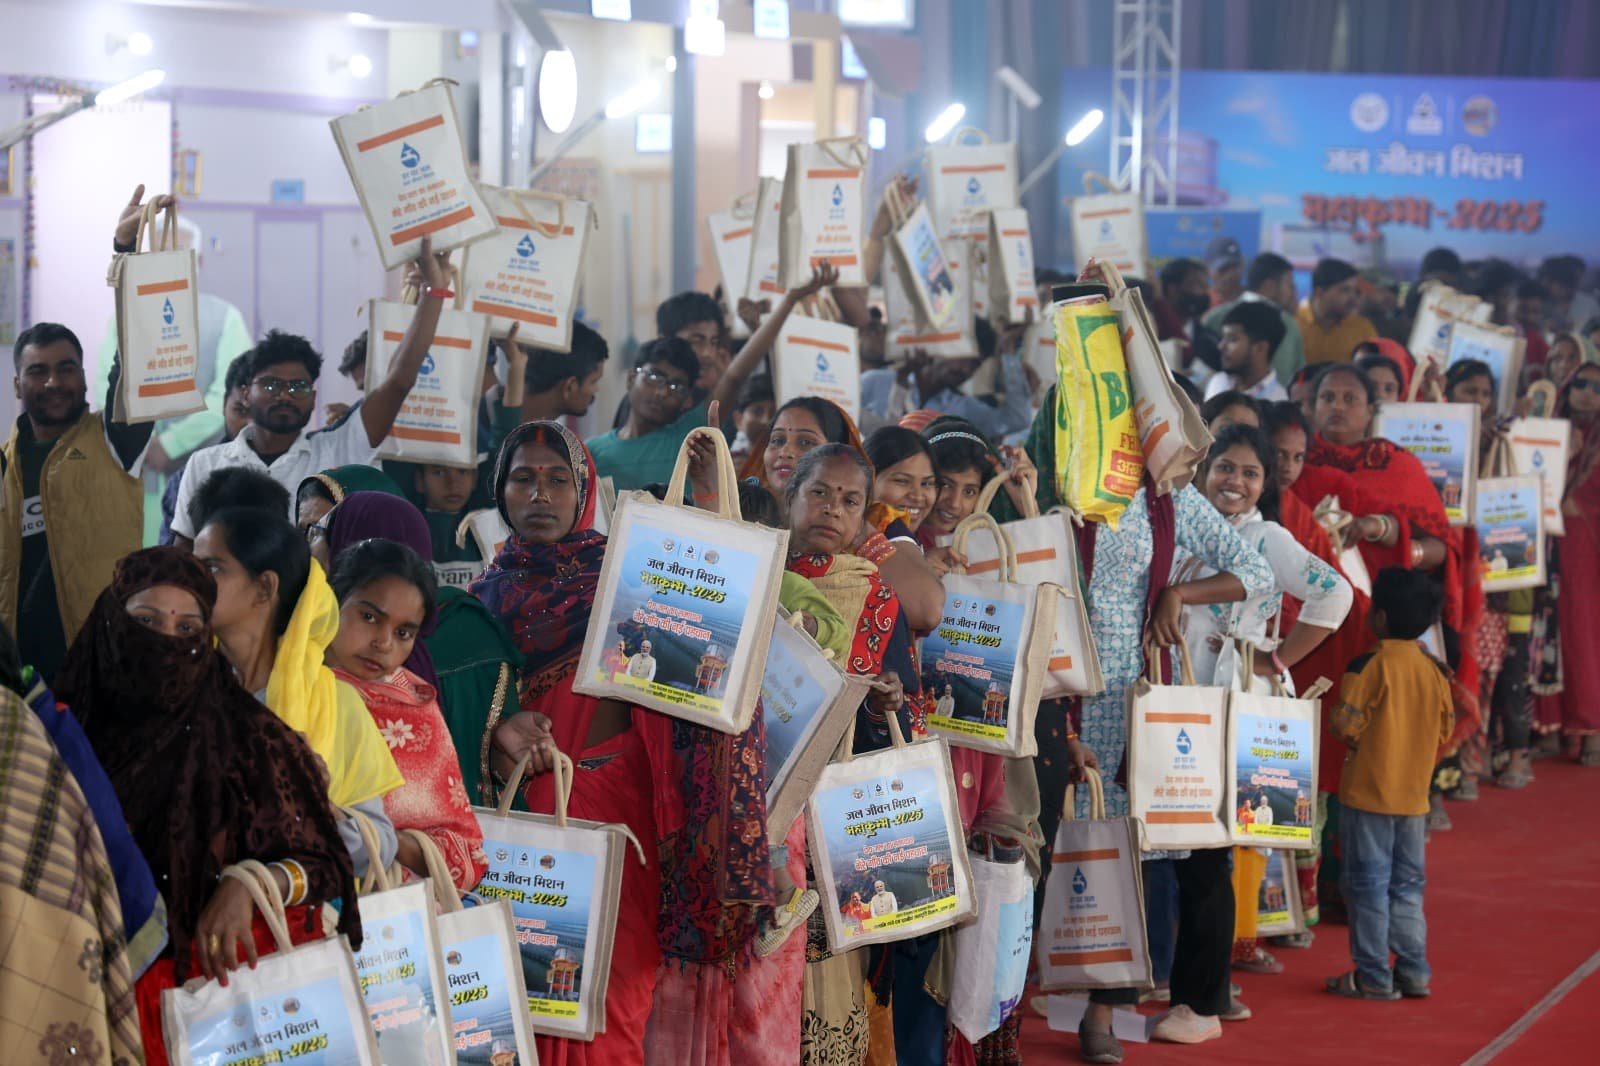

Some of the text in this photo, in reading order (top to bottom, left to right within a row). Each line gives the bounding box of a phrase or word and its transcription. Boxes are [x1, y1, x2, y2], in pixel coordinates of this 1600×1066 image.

[1325, 141, 1523, 180] जल जीवन मिशन
[647, 557, 726, 586] जल जीवन मिशन
[943, 616, 1001, 633] जल जीवन मिशन
[845, 796, 917, 820] जल जीवन मिशन
[502, 871, 531, 887] जीवन
[534, 874, 565, 890] मिशन
[383, 946, 409, 961] मिशन
[448, 971, 480, 988] मिशन
[225, 1040, 248, 1055] जल
[284, 1019, 320, 1038] मिशन
